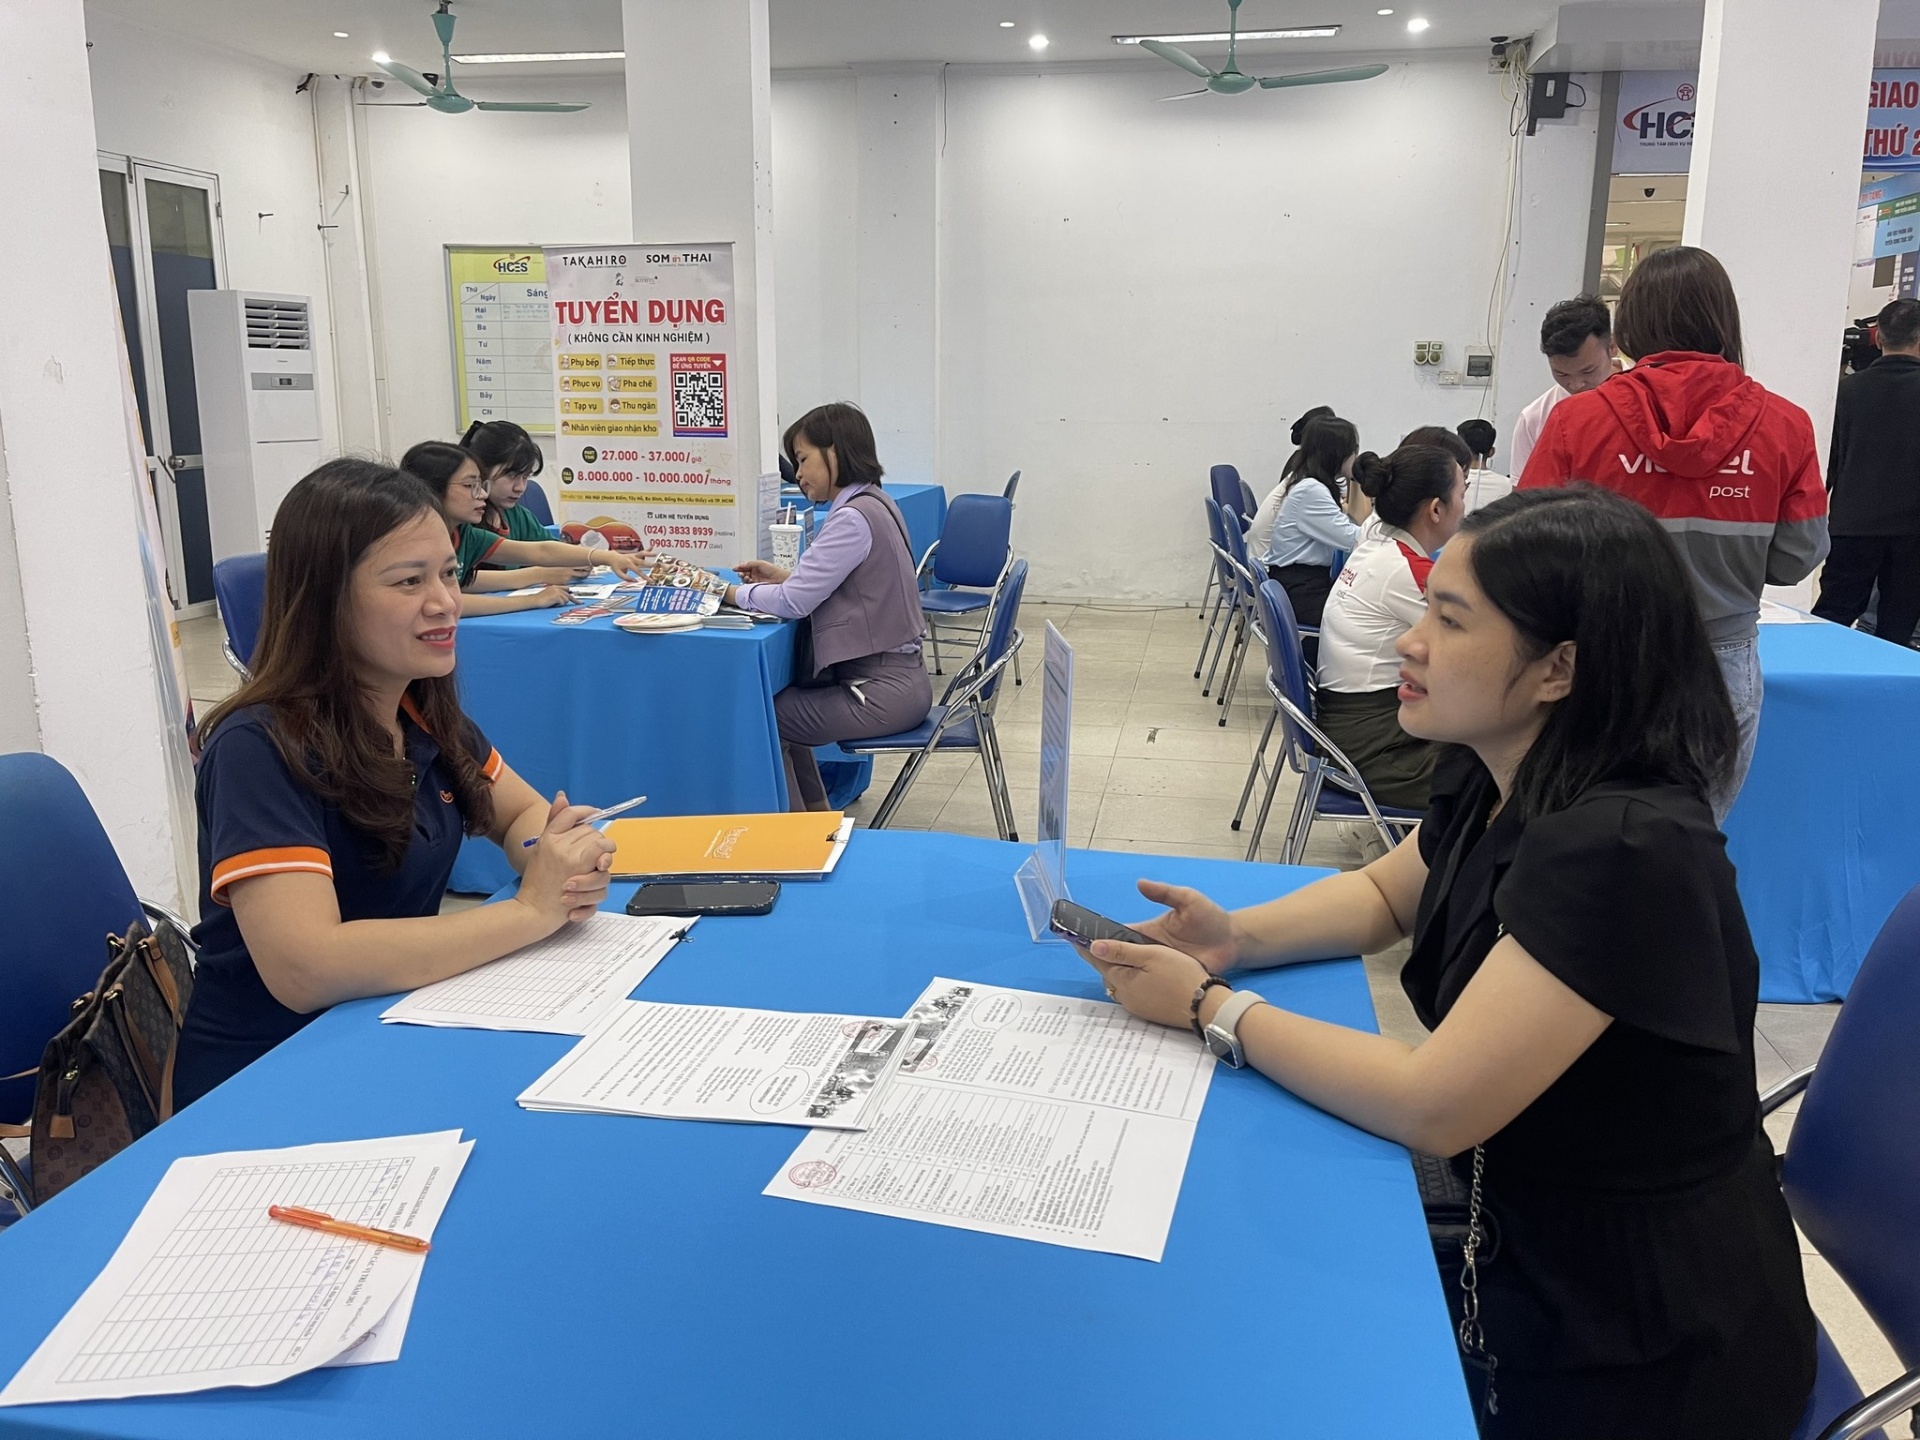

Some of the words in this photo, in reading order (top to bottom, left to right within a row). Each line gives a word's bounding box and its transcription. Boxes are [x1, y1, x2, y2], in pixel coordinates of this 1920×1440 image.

[1868, 81, 1919, 108] GIAO
[1864, 124, 1908, 155] THỨ
[563, 255, 627, 268] TAKAHIRO
[646, 254, 670, 263] SOM
[682, 253, 712, 262] THAI
[498, 262, 528, 272] HCES
[554, 292, 638, 324] TUYỂN
[648, 299, 725, 328] DỤNG
[574, 331, 609, 343] KHÔNG
[612, 330, 632, 342] CẦN
[636, 333, 660, 342] KINH
[663, 332, 703, 344] NGHIỆM
[571, 359, 584, 368] Phụ
[586, 357, 599, 367] bếp
[620, 357, 635, 366] Tiếp
[637, 358, 655, 366] thực
[573, 380, 590, 389] Phục
[638, 379, 652, 387] chế
[574, 403, 587, 411] Tạp
[638, 402, 656, 411] ngân
[608, 425, 622, 434] giao
[623, 424, 642, 433] nhận
[602, 451, 638, 461] 27.000
[578, 472, 632, 482] 8.000.000
[1709, 485, 1750, 498] post
[644, 525, 666, 536] (024)
[669, 526, 690, 535] 3833
[692, 527, 713, 536] 8939
[650, 539, 708, 549] 0903.705.177
